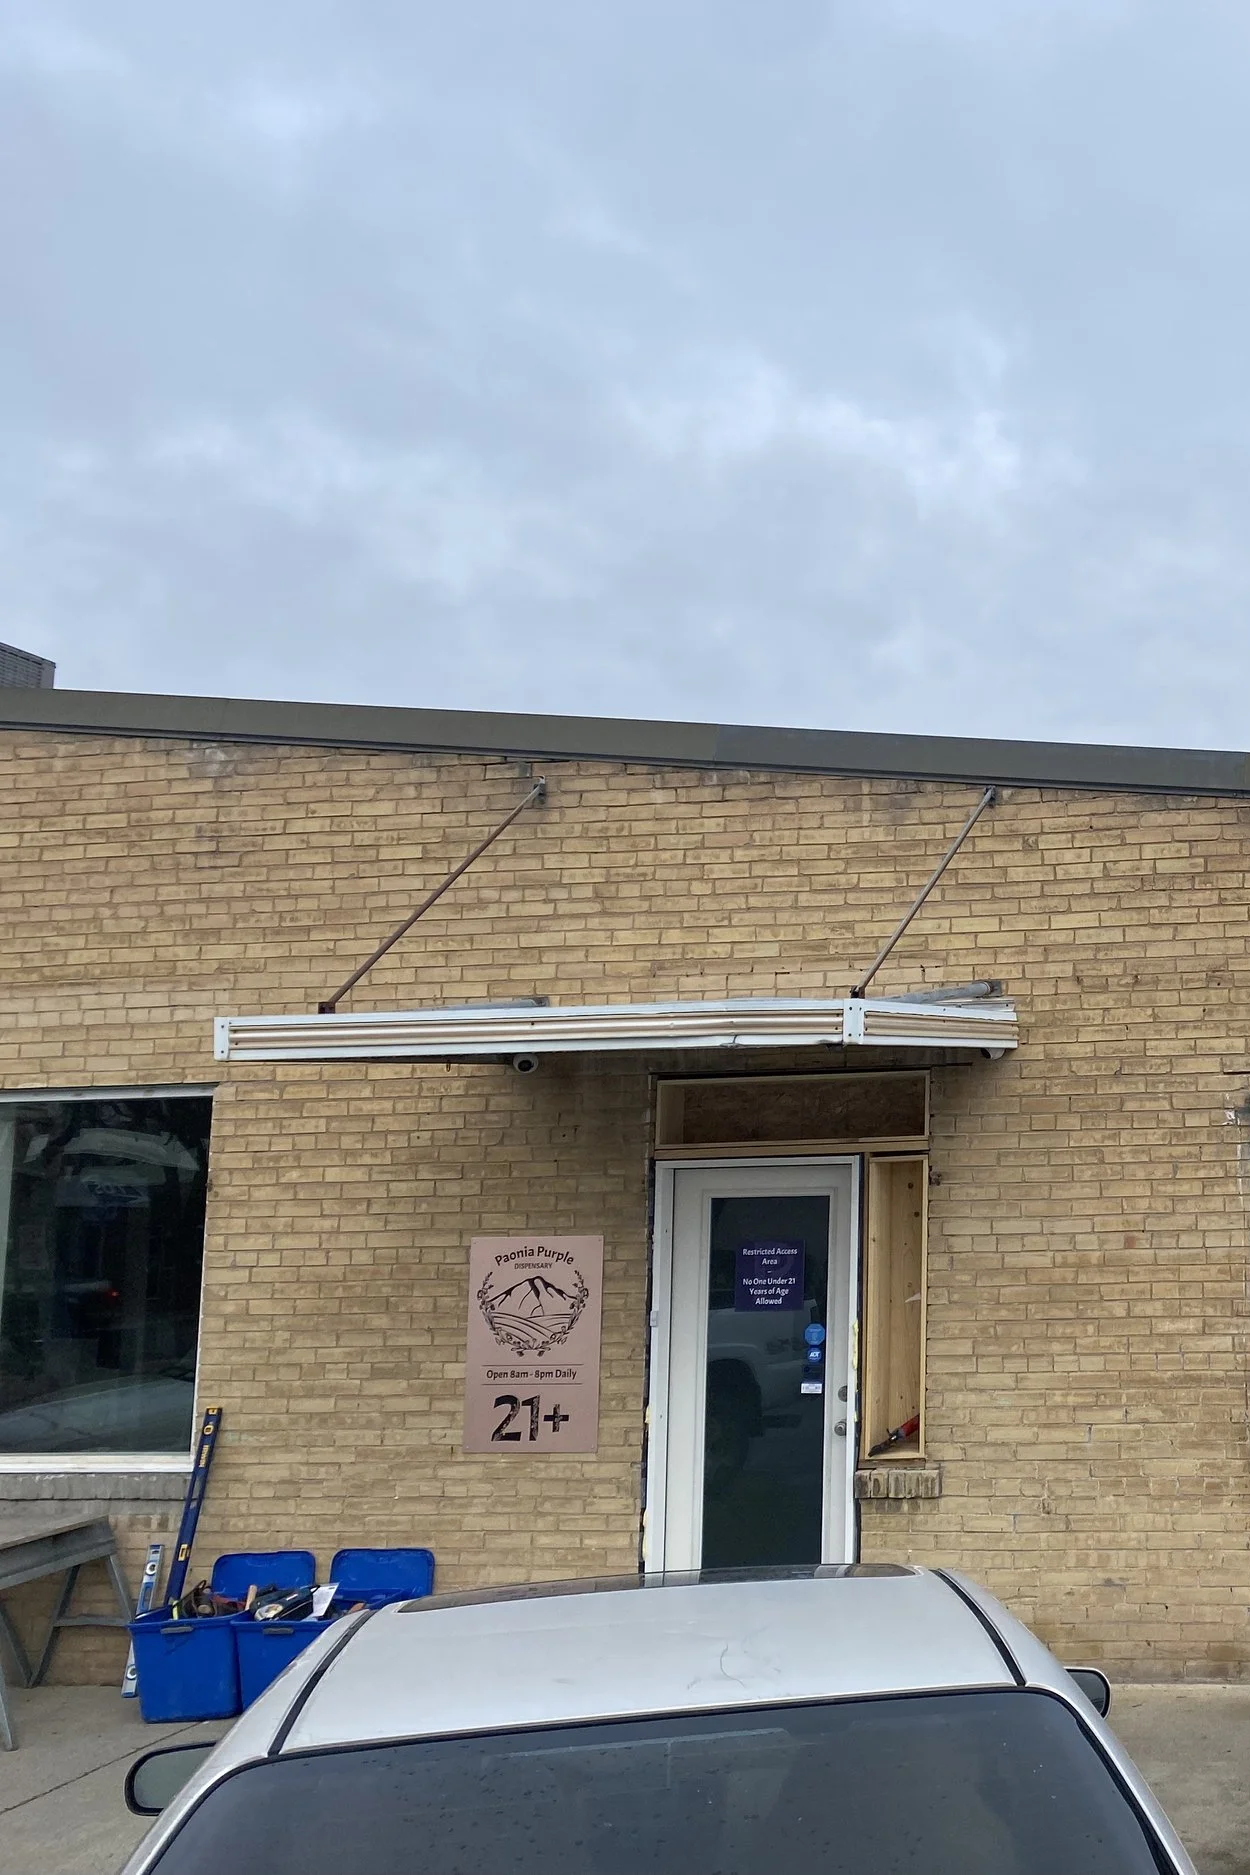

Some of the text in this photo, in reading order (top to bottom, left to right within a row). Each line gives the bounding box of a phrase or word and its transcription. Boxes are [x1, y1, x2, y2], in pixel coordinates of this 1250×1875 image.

[494, 1246, 574, 1267] Paonia Purple
[742, 1248, 775, 1256] Restricted
[514, 1262, 553, 1270] DISPENSARY
[742, 1278, 753, 1286] No
[767, 1277, 788, 1285] Under
[768, 1287, 775, 1295] of
[775, 1287, 789, 1297] Age
[755, 1297, 783, 1305] Allowed
[486, 1370, 508, 1380] Open
[509, 1370, 529, 1379] 8am
[534, 1370, 554, 1380] 8pm
[555, 1368, 577, 1380] Daily
[491, 1394, 570, 1442] 21+
